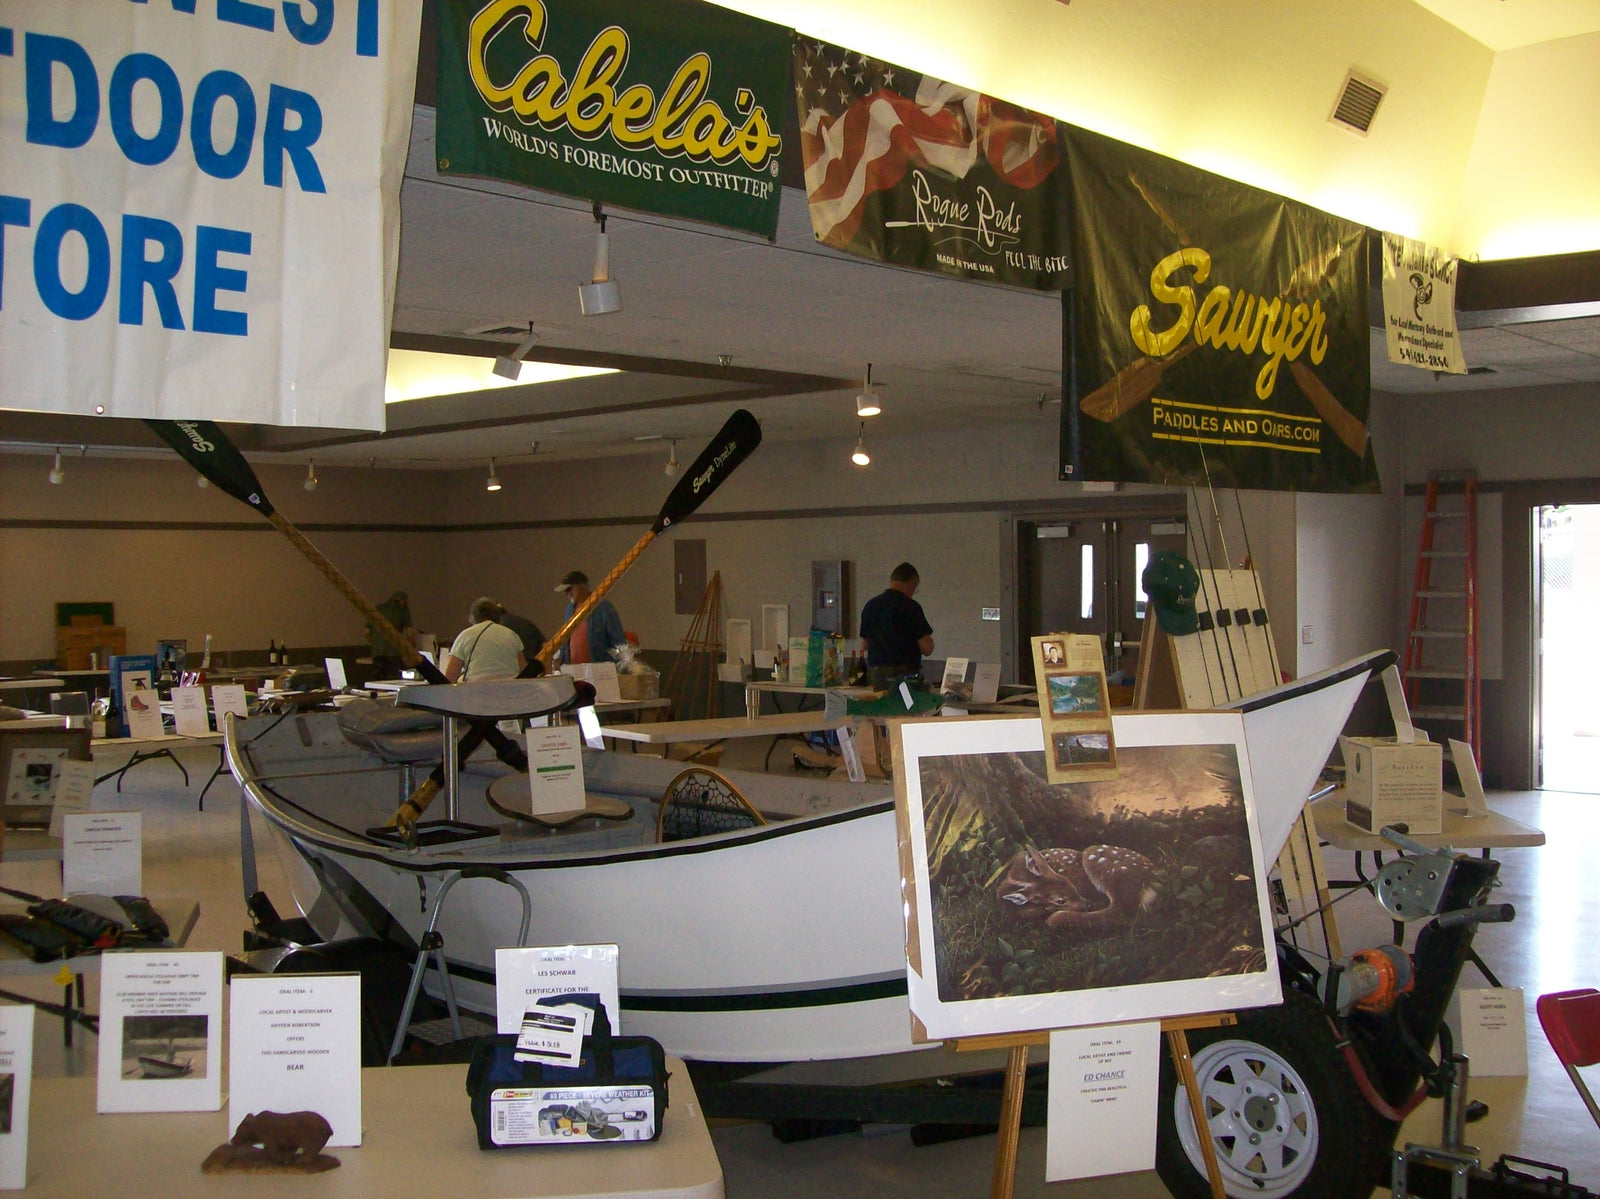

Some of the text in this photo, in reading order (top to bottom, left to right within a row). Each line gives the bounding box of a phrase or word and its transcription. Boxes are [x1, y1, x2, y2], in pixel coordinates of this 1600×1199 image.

[468, 0, 783, 172] Cabela's
[0, 27, 327, 194] DOOR
[482, 117, 768, 200] WORLD'S FOREMOST OUTFITTER
[912, 169, 1022, 248] Rogue Rods
[936, 253, 995, 274] MADE IN THE USA
[1129, 247, 1328, 400] Sawyer
[1153, 406, 1320, 442] PADDLES AND OARS.COM
[525, 987, 563, 995] CERTIFICATE
[549, 969, 577, 977] SCHWAB
[1084, 1070, 1126, 1082] ED CHANCE
[558, 1091, 577, 1100] PIECE
[607, 1089, 638, 1099] WEATHER
[638, 1089, 650, 1097] KIT
